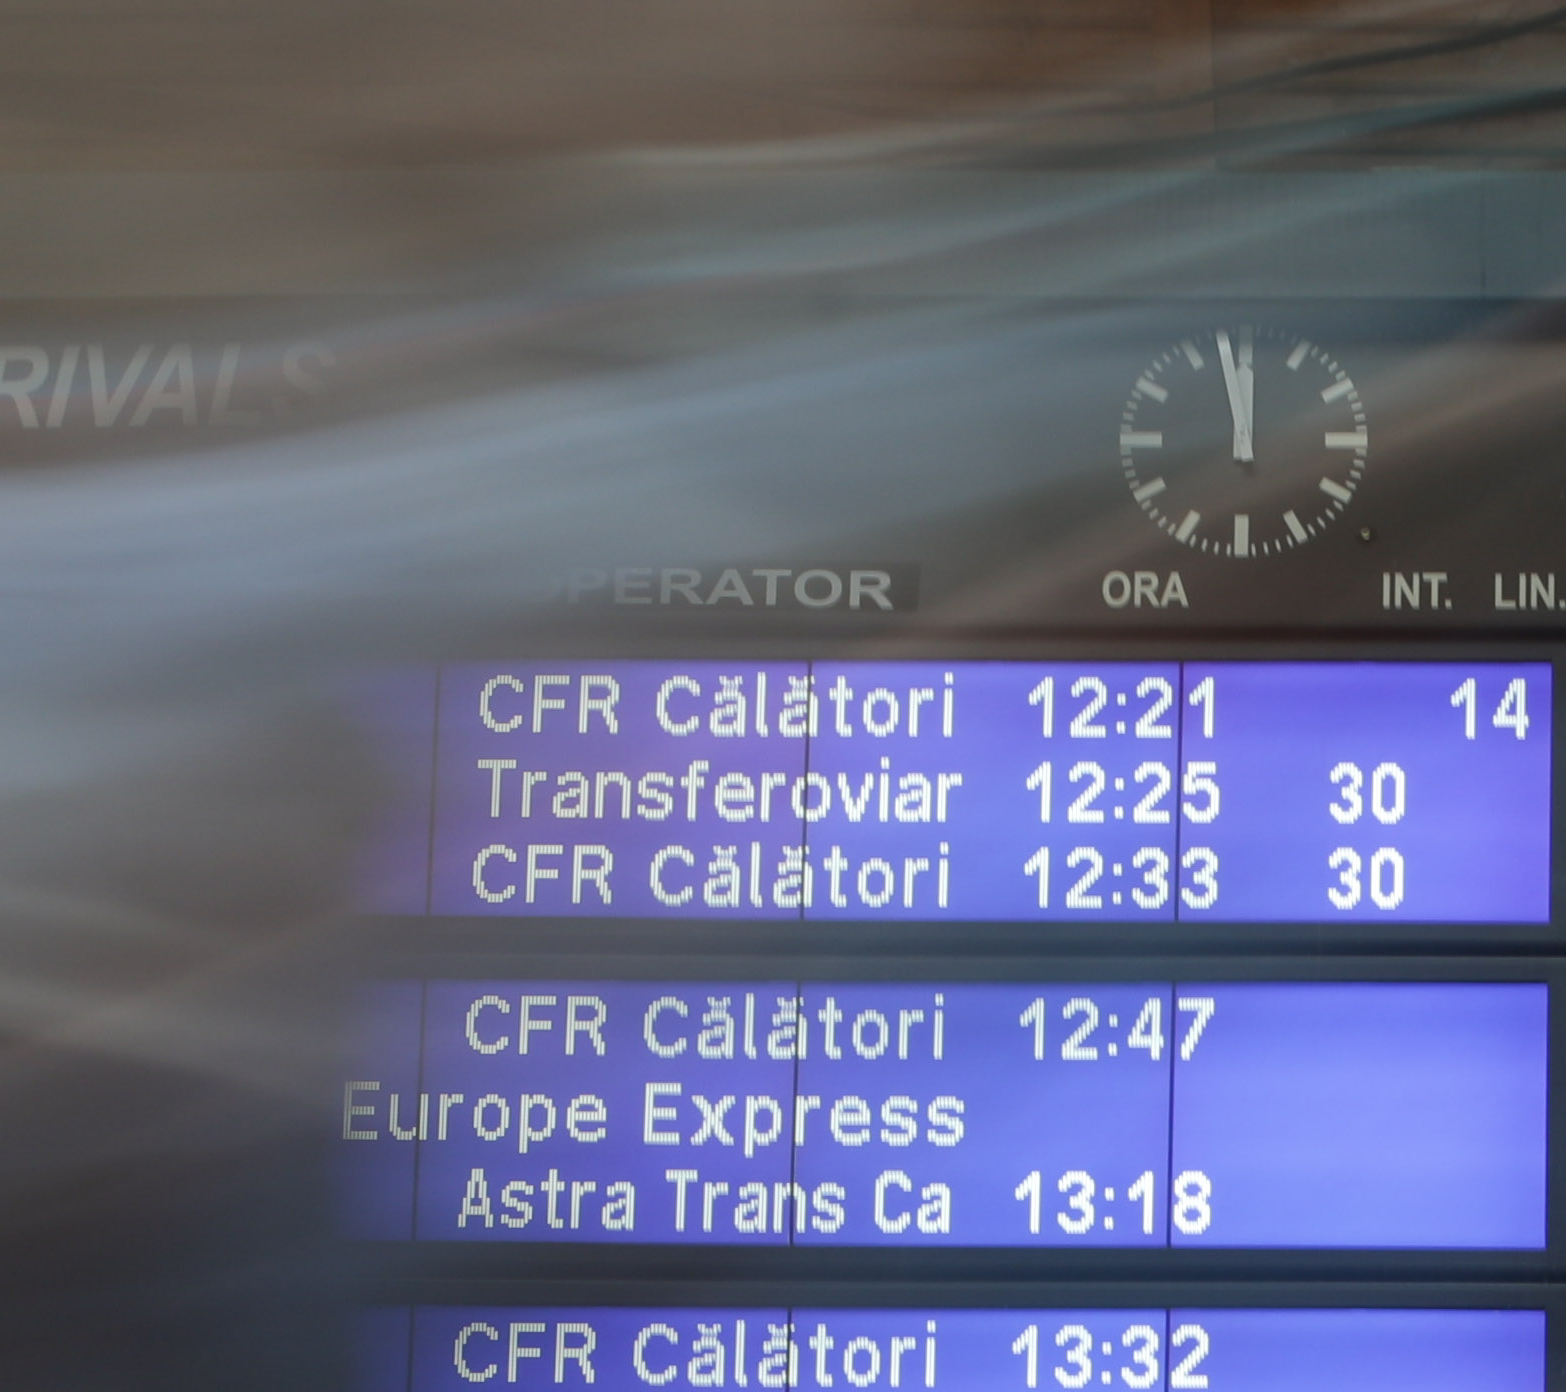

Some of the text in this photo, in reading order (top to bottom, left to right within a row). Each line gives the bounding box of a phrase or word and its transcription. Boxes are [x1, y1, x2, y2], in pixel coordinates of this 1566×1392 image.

[552, 566, 894, 611] PERATOR
[1101, 570, 1189, 609] ORA
[1380, 573, 1566, 611] INT. LIN.
[480, 671, 1529, 740] CFR Călători 12:21 14
[478, 756, 1406, 825] Transferoviar 12:25 30
[341, 1082, 965, 1158] Europe Express
[458, 1168, 1212, 1235] Astra Trans Ca 13:18
